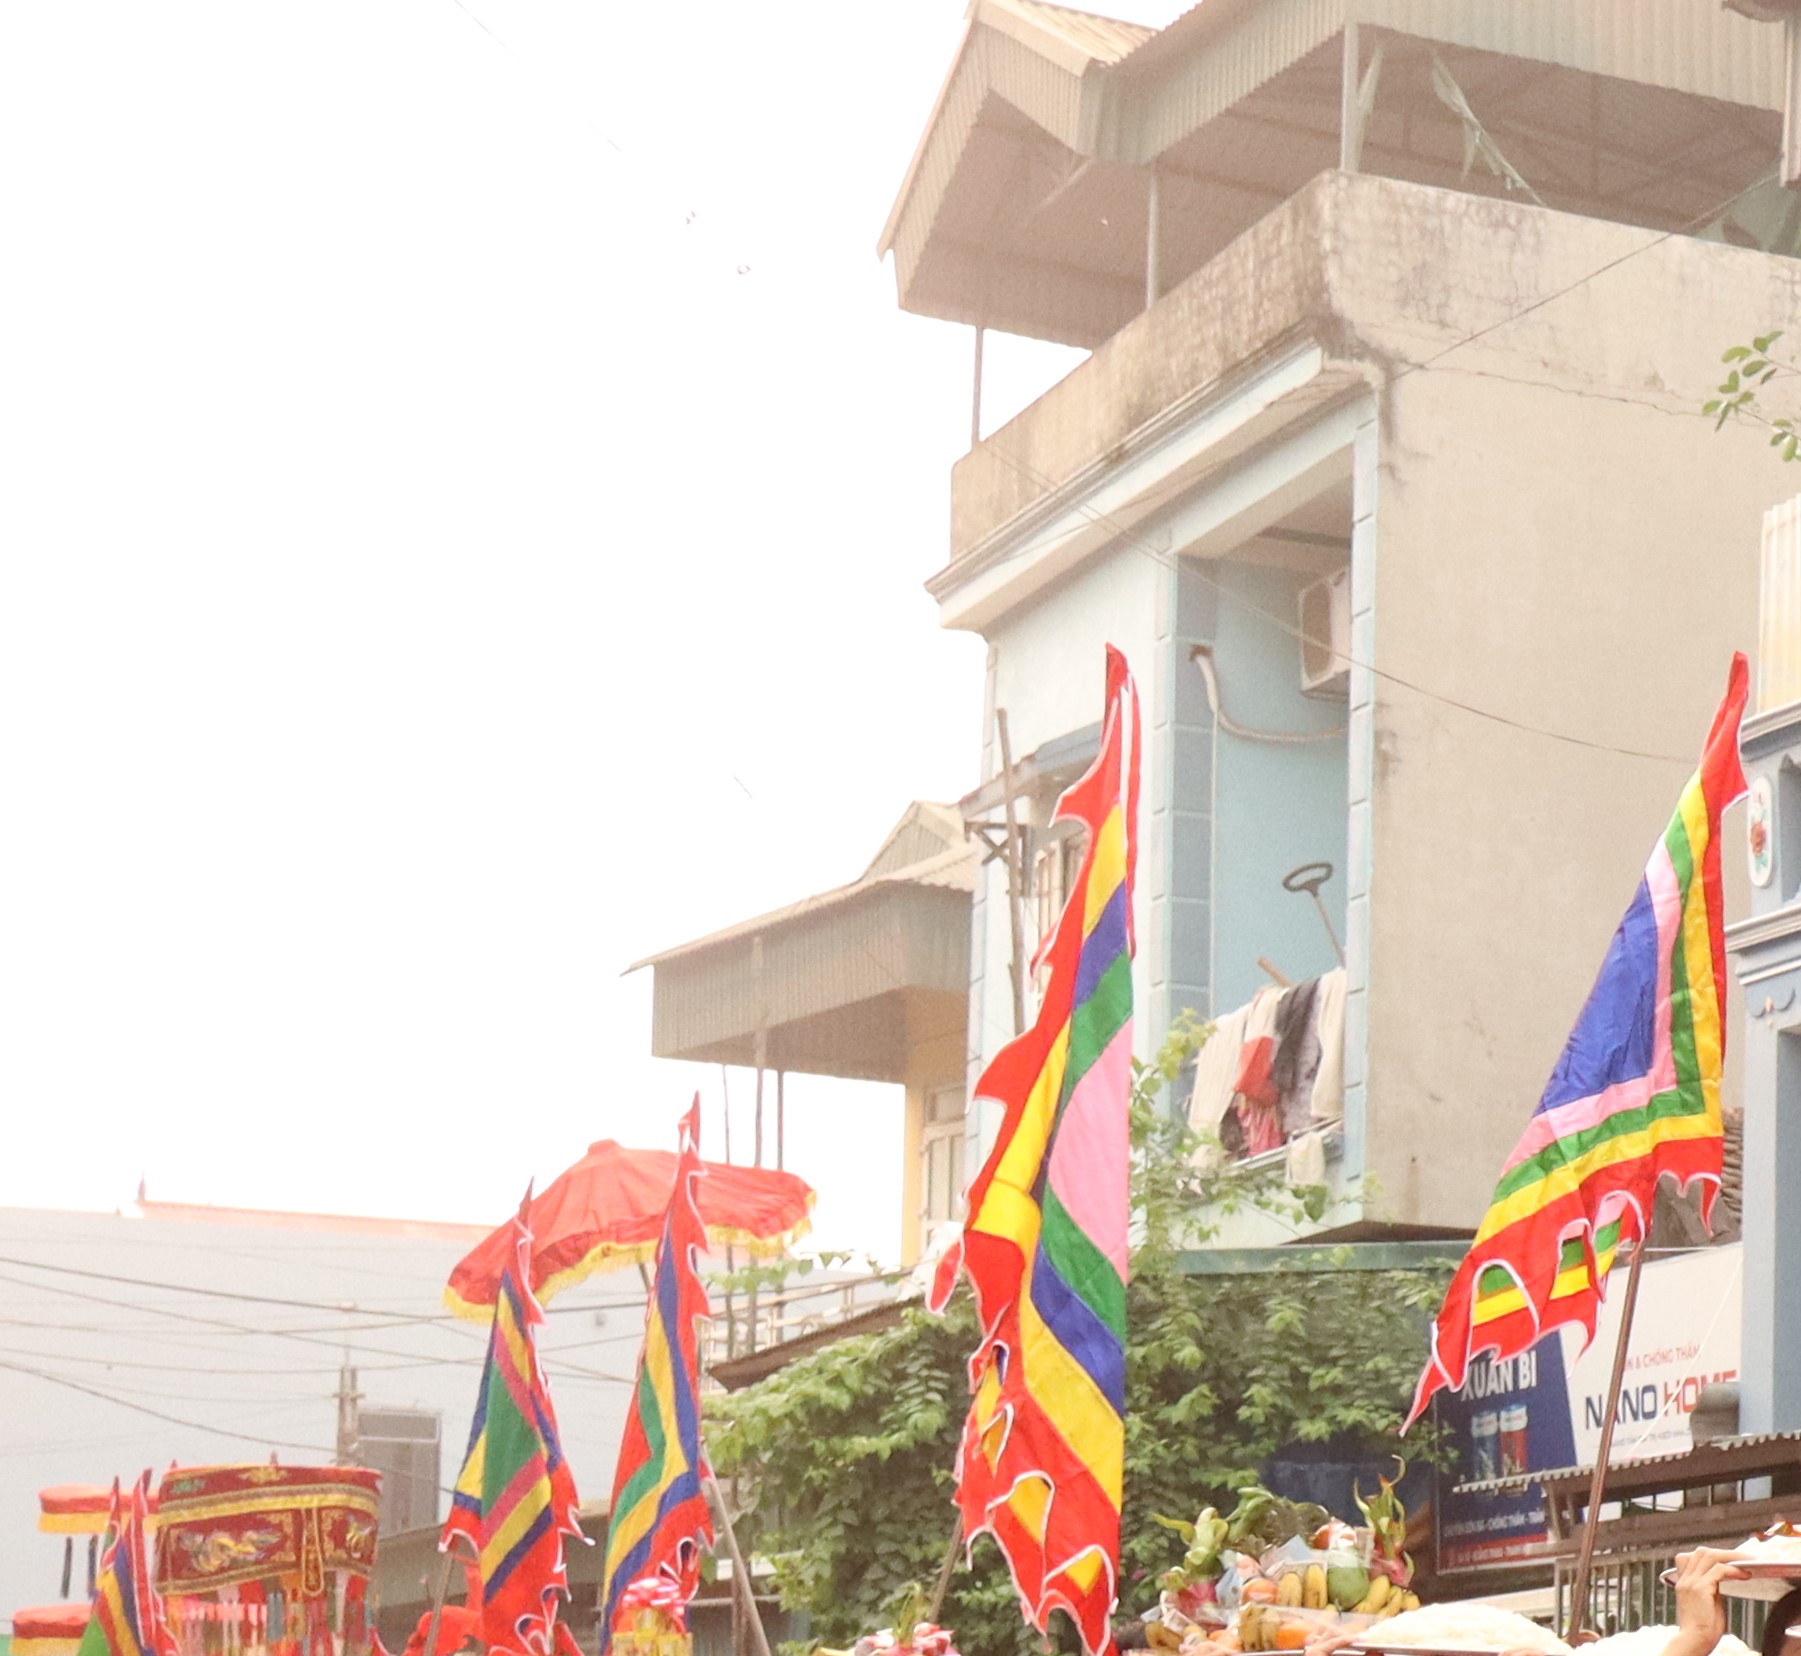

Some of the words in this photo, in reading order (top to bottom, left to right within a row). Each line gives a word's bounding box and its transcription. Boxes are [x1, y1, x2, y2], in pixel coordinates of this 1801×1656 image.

[1518, 1351, 1537, 1390] BI
[1586, 1384, 1657, 1430] NNO
[1664, 1370, 1737, 1416] HO
